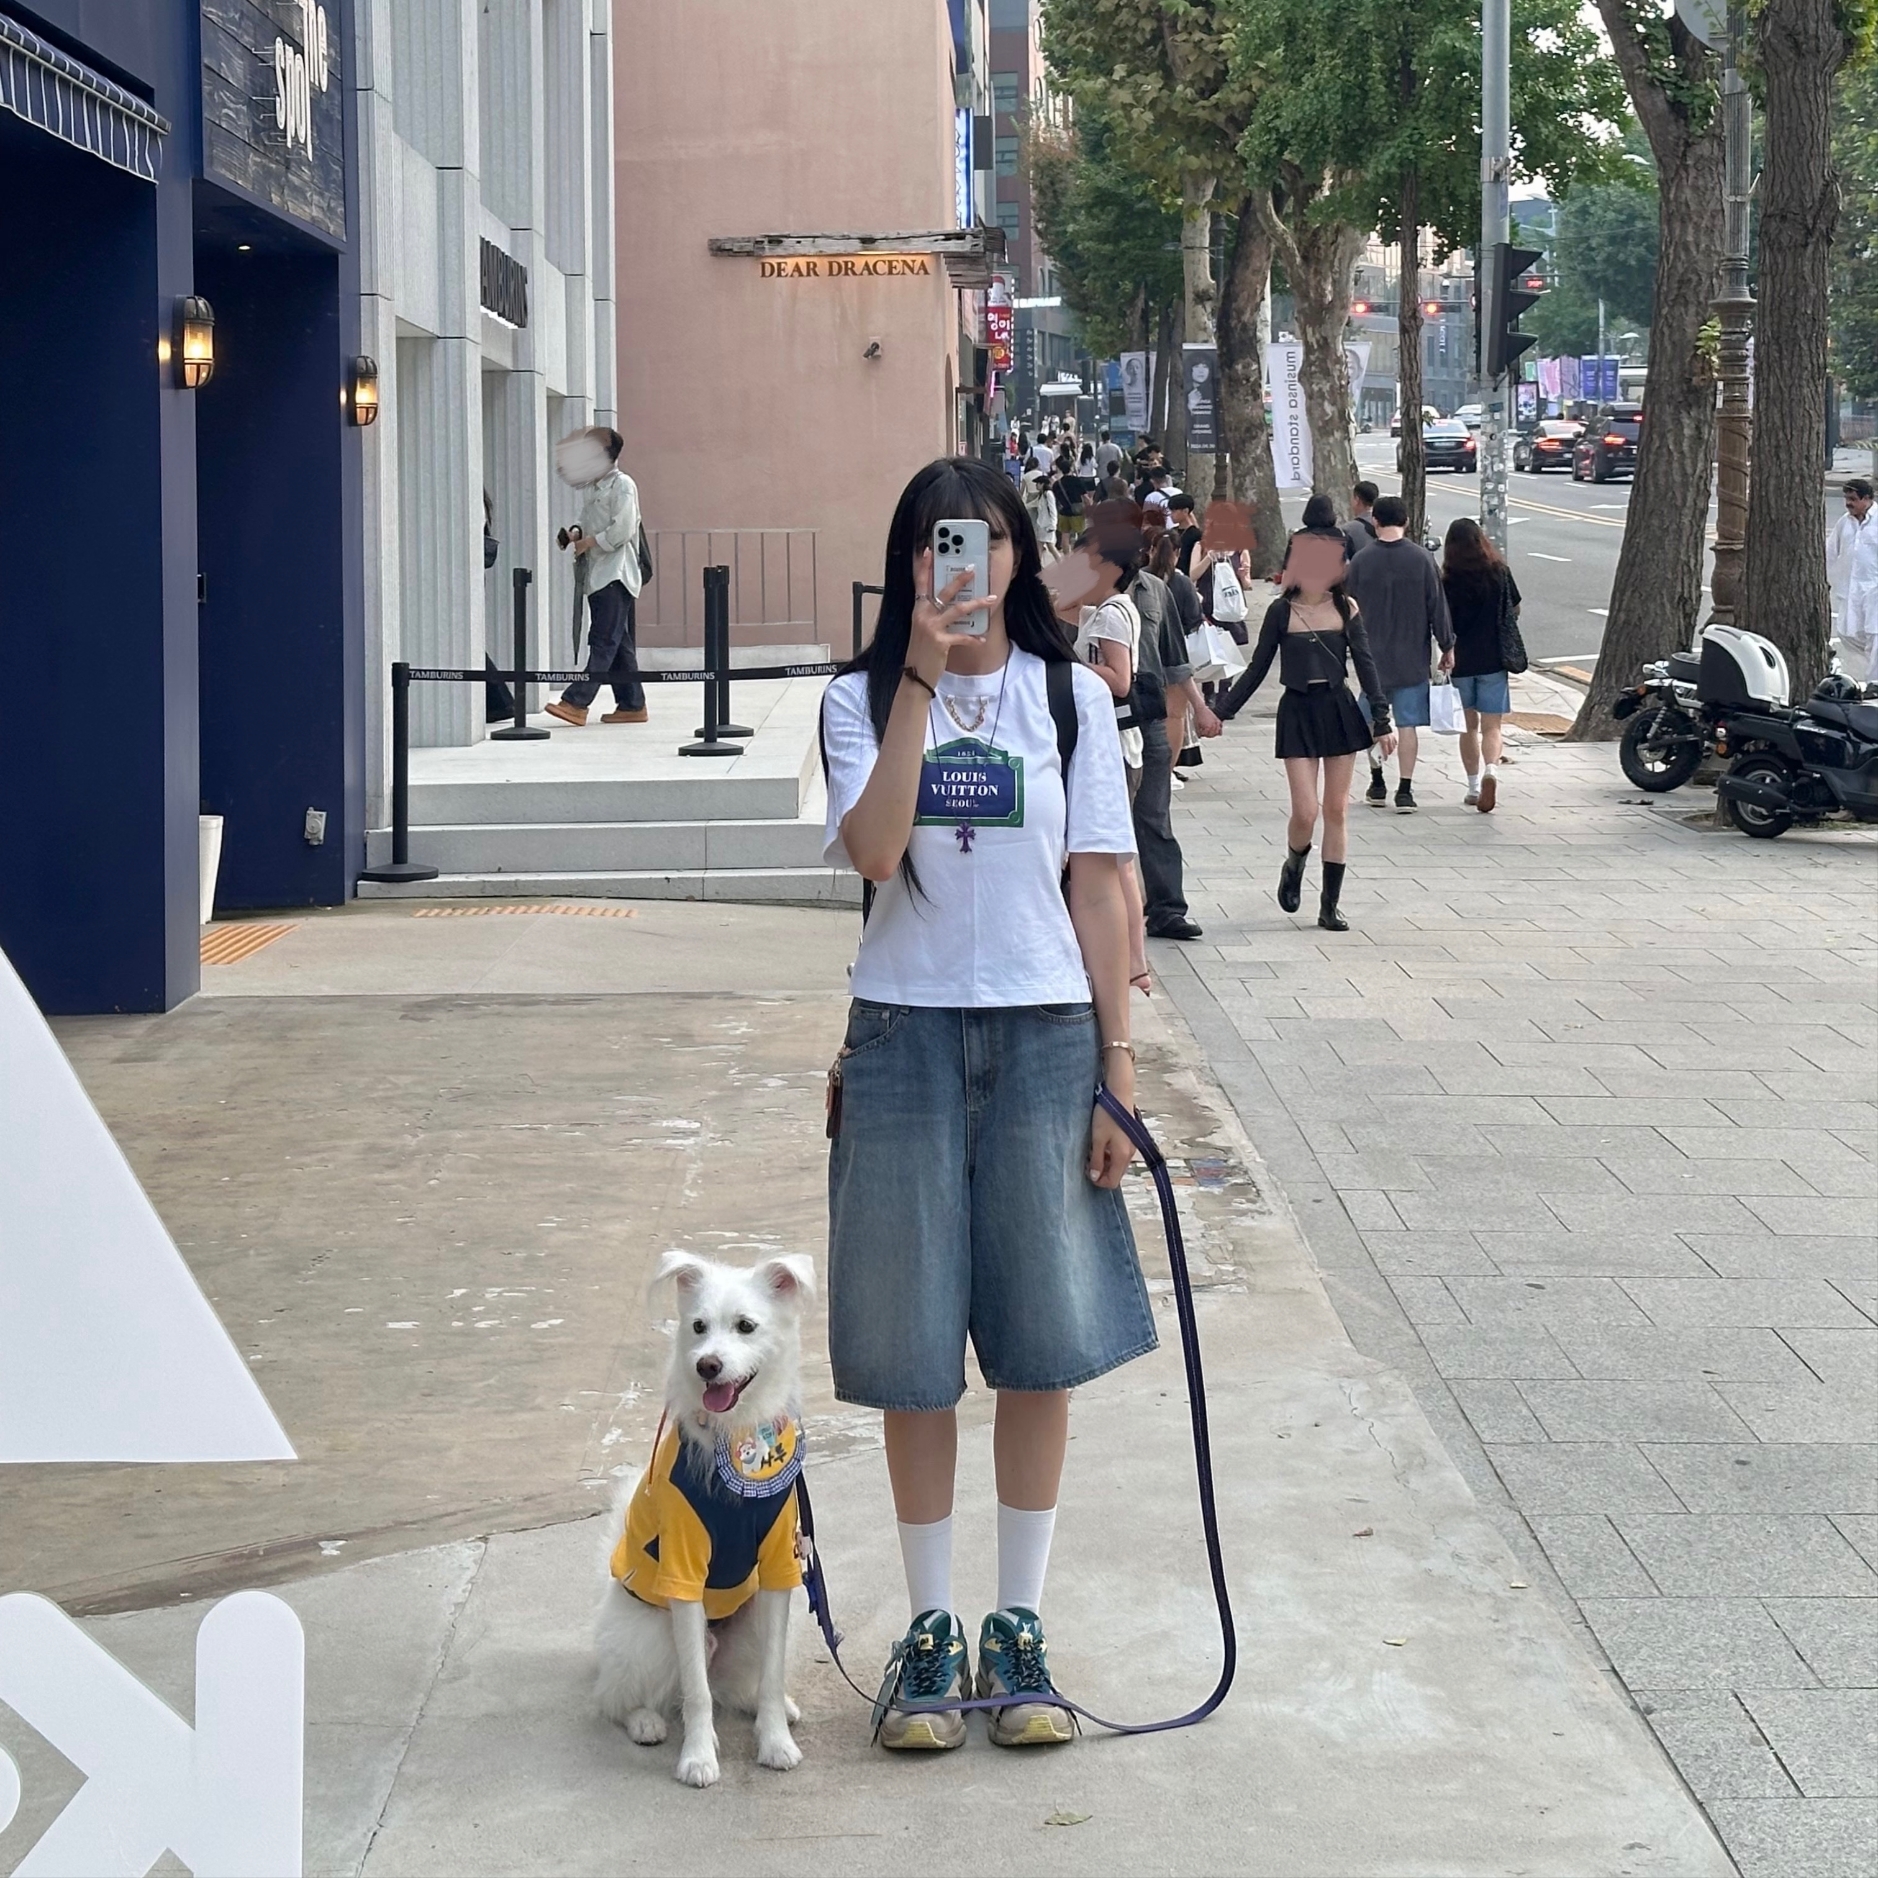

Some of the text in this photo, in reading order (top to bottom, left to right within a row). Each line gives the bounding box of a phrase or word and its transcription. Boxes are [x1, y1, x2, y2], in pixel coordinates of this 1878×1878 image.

[760, 259, 929, 278] DEAR DRACENA
[410, 671, 463, 680] TAMBURINS
[785, 665, 837, 676] TAMBURINS
[535, 673, 590, 682] TAMBURINS
[661, 672, 715, 681] TAMBURINS
[943, 771, 987, 782] LOUIS
[931, 784, 999, 796] VUITTON
[945, 799, 979, 808] SEOUL
